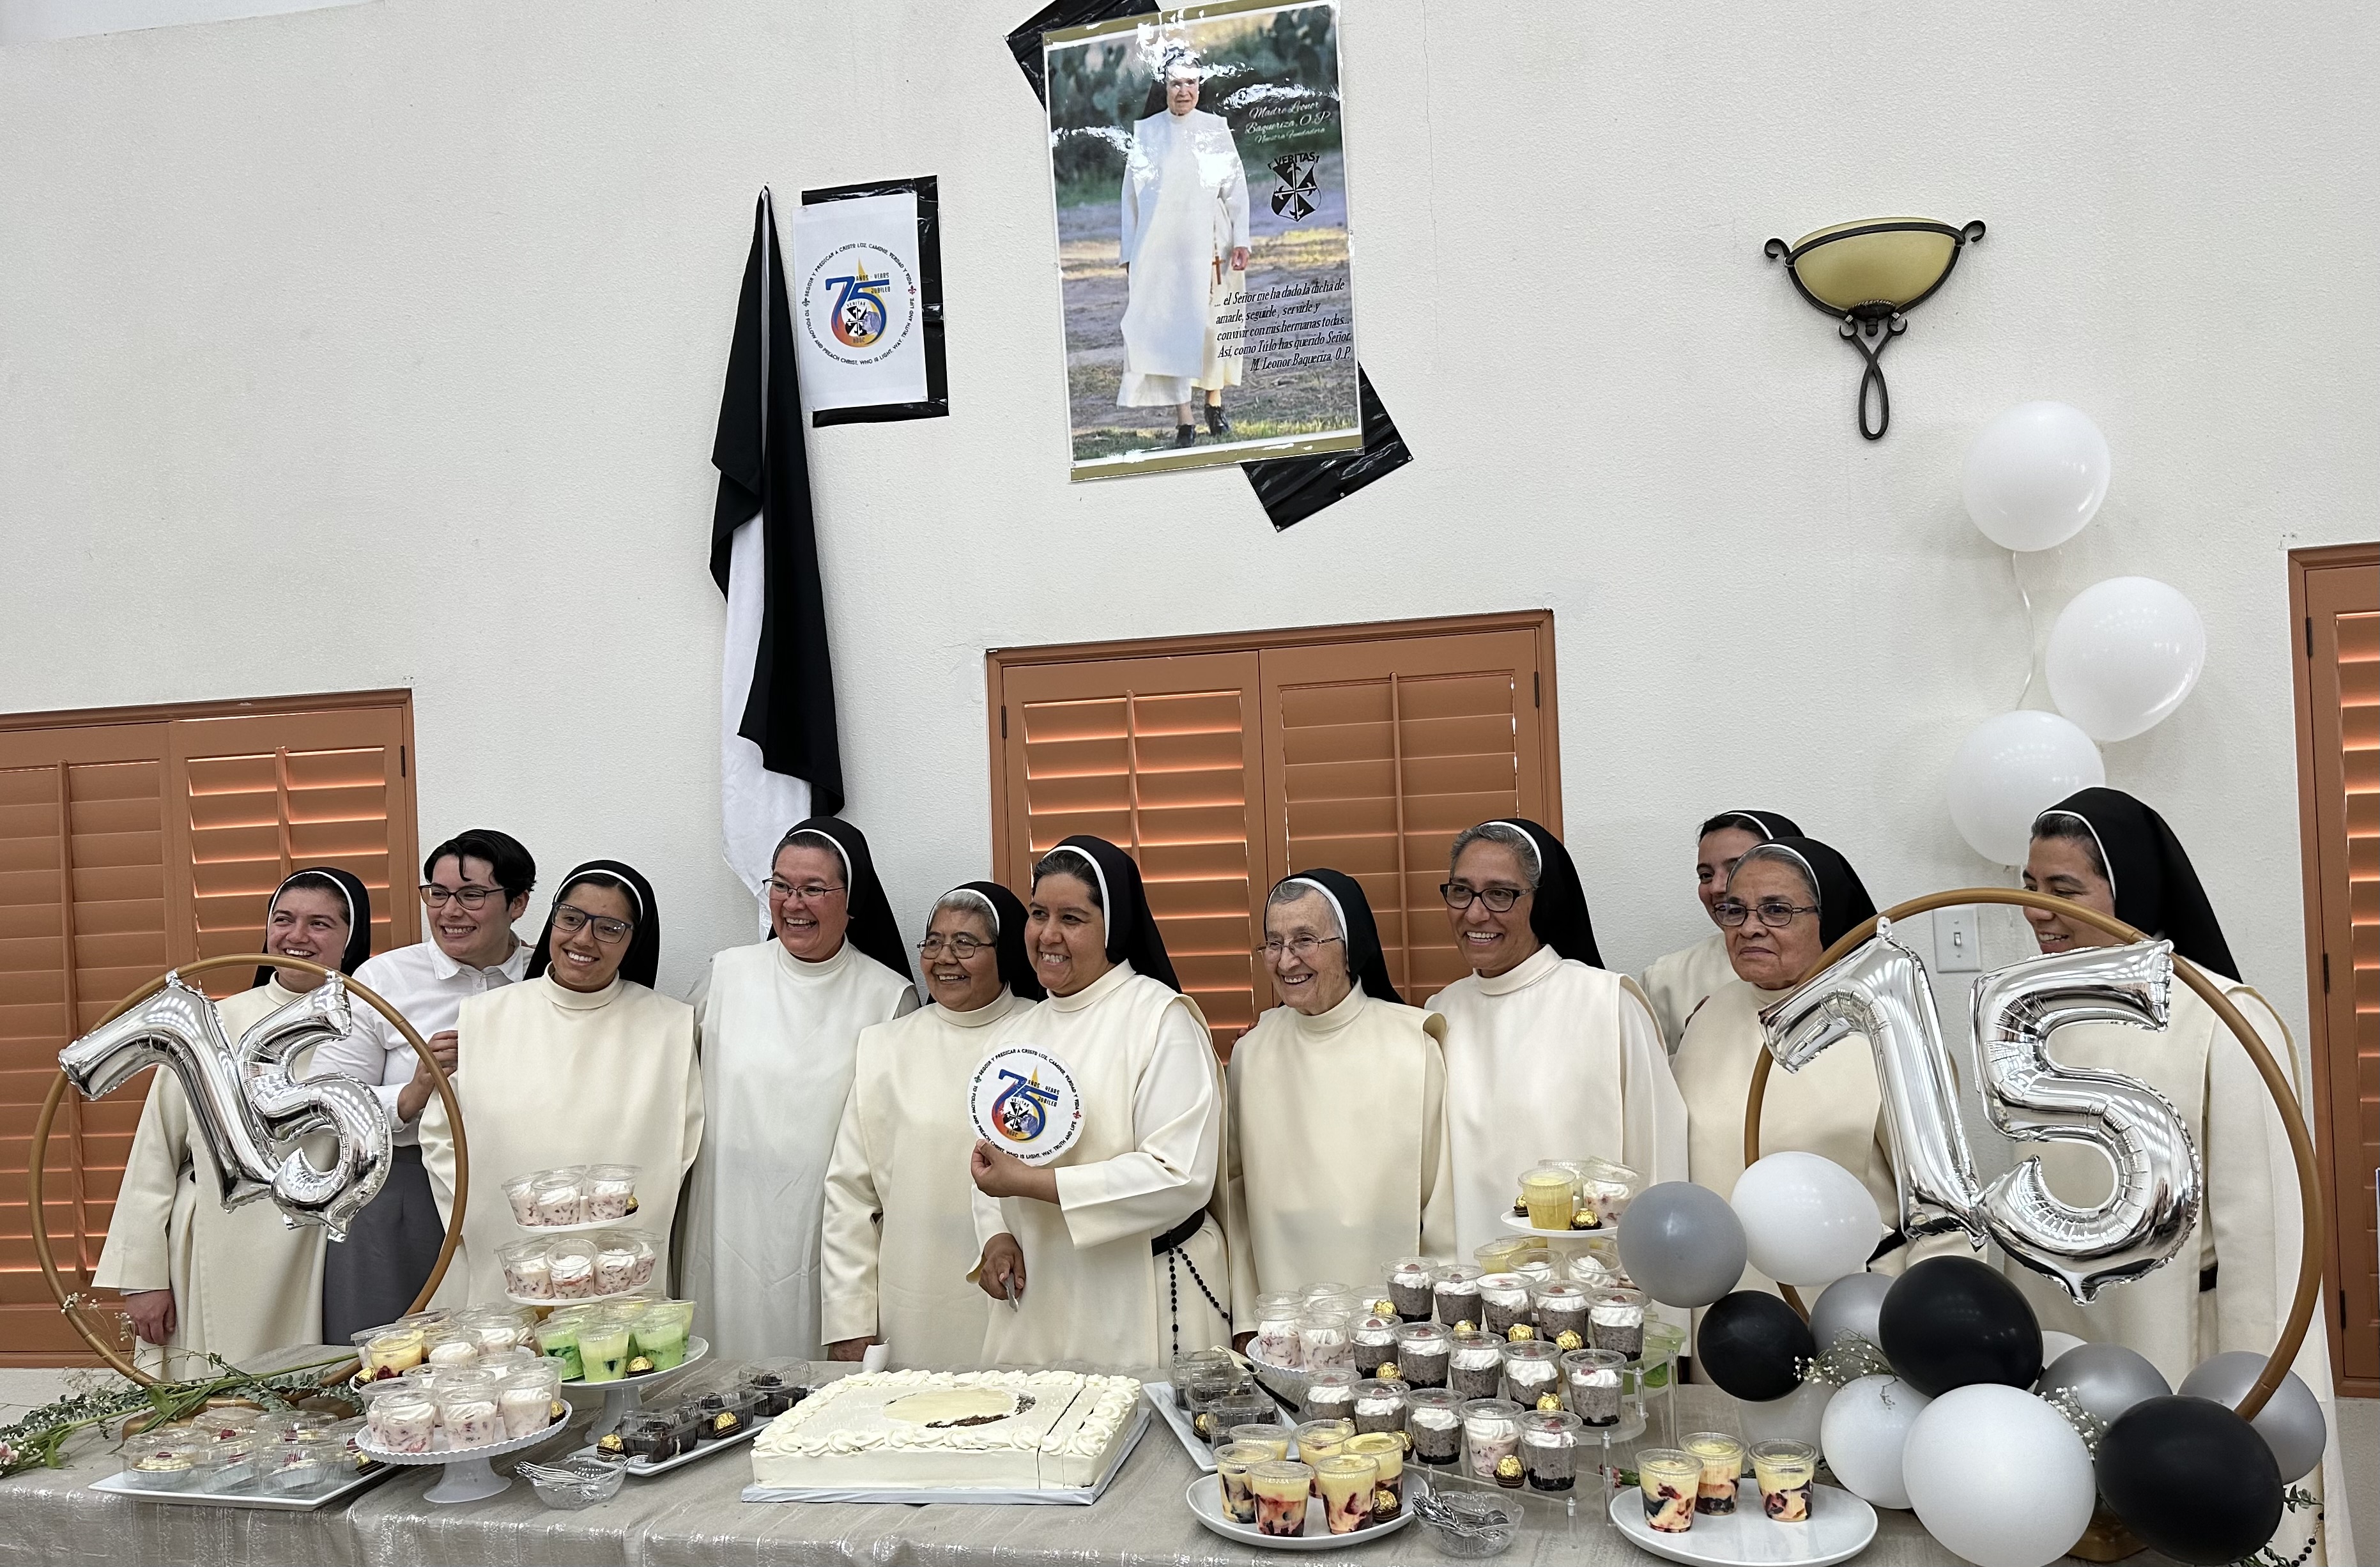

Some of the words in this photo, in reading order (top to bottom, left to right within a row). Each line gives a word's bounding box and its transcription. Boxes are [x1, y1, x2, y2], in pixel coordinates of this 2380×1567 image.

[1249, 106, 1287, 118] Madre
[1274, 151, 1315, 165] VERITAS
[815, 252, 834, 272] PREDICAR
[840, 243, 856, 252] CRISTO
[889, 252, 904, 268] VERDAD
[1224, 293, 1232, 305] el
[1232, 291, 1255, 305] Señor
[1257, 291, 1270, 302] me
[1270, 287, 1281, 300] ha
[1281, 283, 1301, 298] dado
[1301, 282, 1311, 295] la
[1311, 280, 1333, 293] dicha
[1335, 278, 1345, 291] de
[825, 276, 889, 348] 75
[1216, 312, 1243, 324] amarle,
[1282, 300, 1312, 316] servirle
[1314, 302, 1321, 314] y
[806, 318, 817, 339] FOLLOW
[815, 340, 823, 348] AND
[822, 348, 840, 361] PREACH
[902, 323, 910, 338] TRUTH
[1217, 327, 1249, 341] convivir
[1250, 326, 1265, 337] con
[1266, 321, 1280, 335] mis
[1281, 319, 1321, 332] hermanas
[1218, 345, 1232, 358] Así,
[1234, 344, 1256, 356] como
[1258, 339, 1268, 353] Tú
[1269, 338, 1277, 351] lo
[1278, 337, 1293, 349] has
[1294, 332, 1324, 349] querido
[1262, 357, 1291, 370] Leonor
[1292, 351, 1332, 367] Baqueriza,
[1335, 346, 1351, 360] O.P.
[979, 1060, 992, 1075] SEGUIR
[995, 1049, 1016, 1060] PREDICAR
[1038, 1096, 1057, 1107] JUBILEO
[1045, 1086, 1060, 1094] YEARS
[58, 969, 392, 1241] 75
[992, 1069, 1059, 1143] 75
[1757, 917, 2202, 1306] 75
[978, 1125, 991, 1142] PREACH
[1053, 1140, 1066, 1150] TRUTH
